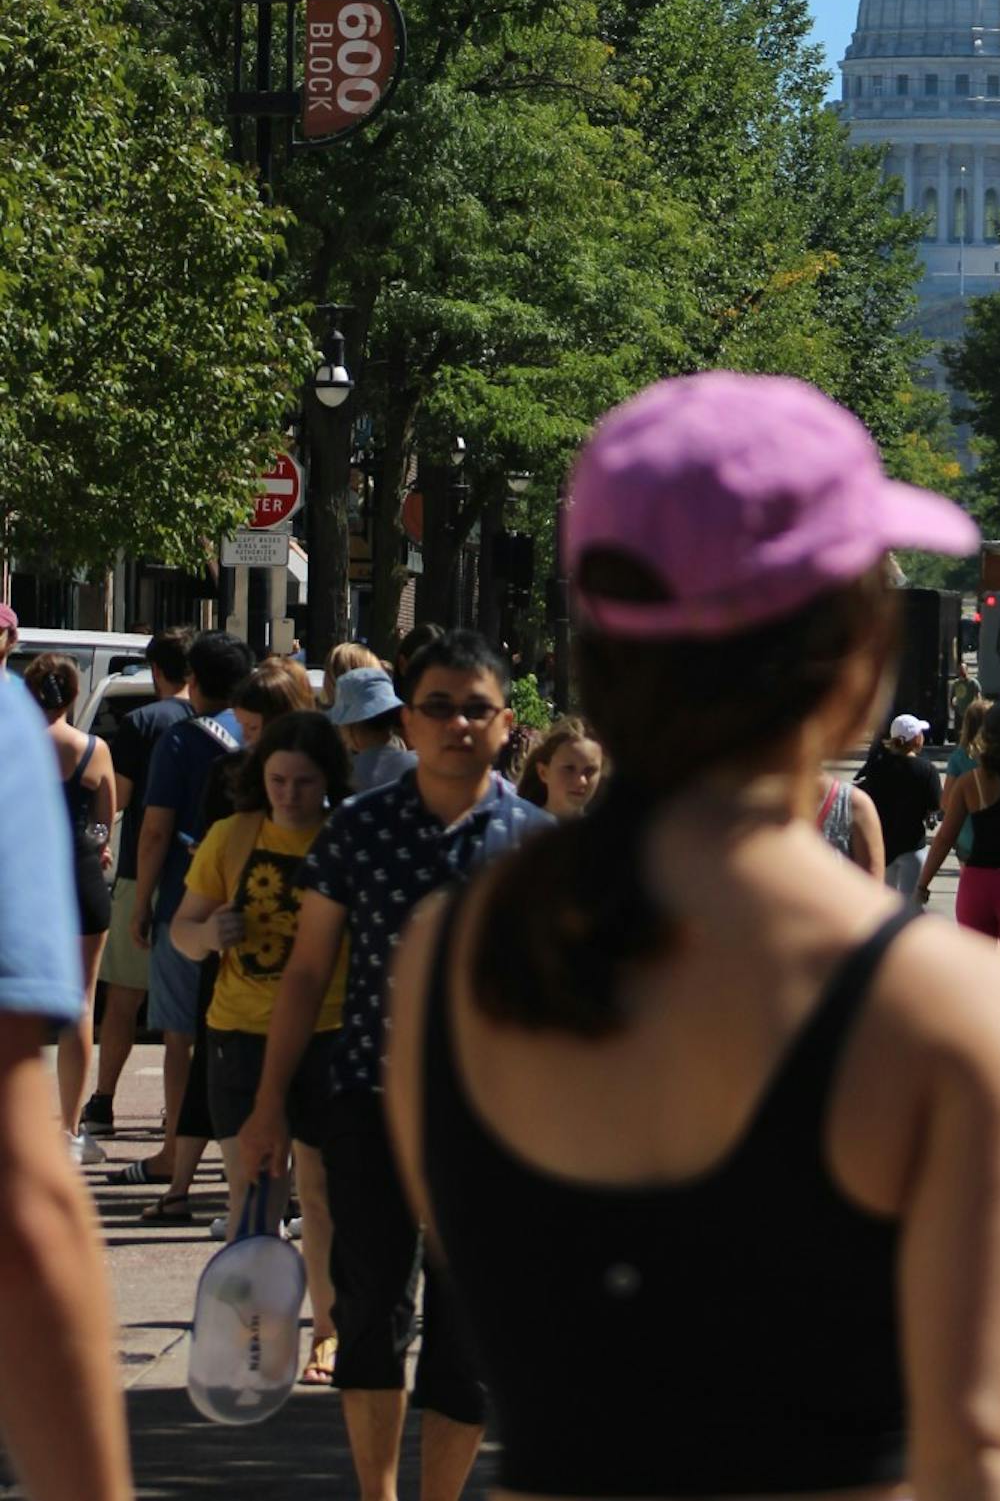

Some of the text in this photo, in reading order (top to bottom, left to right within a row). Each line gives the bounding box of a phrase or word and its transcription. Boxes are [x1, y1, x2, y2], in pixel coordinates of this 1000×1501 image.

[308, 22, 334, 111] BLOCK
[337, 2, 382, 114] 600
[254, 498, 283, 512] TER
